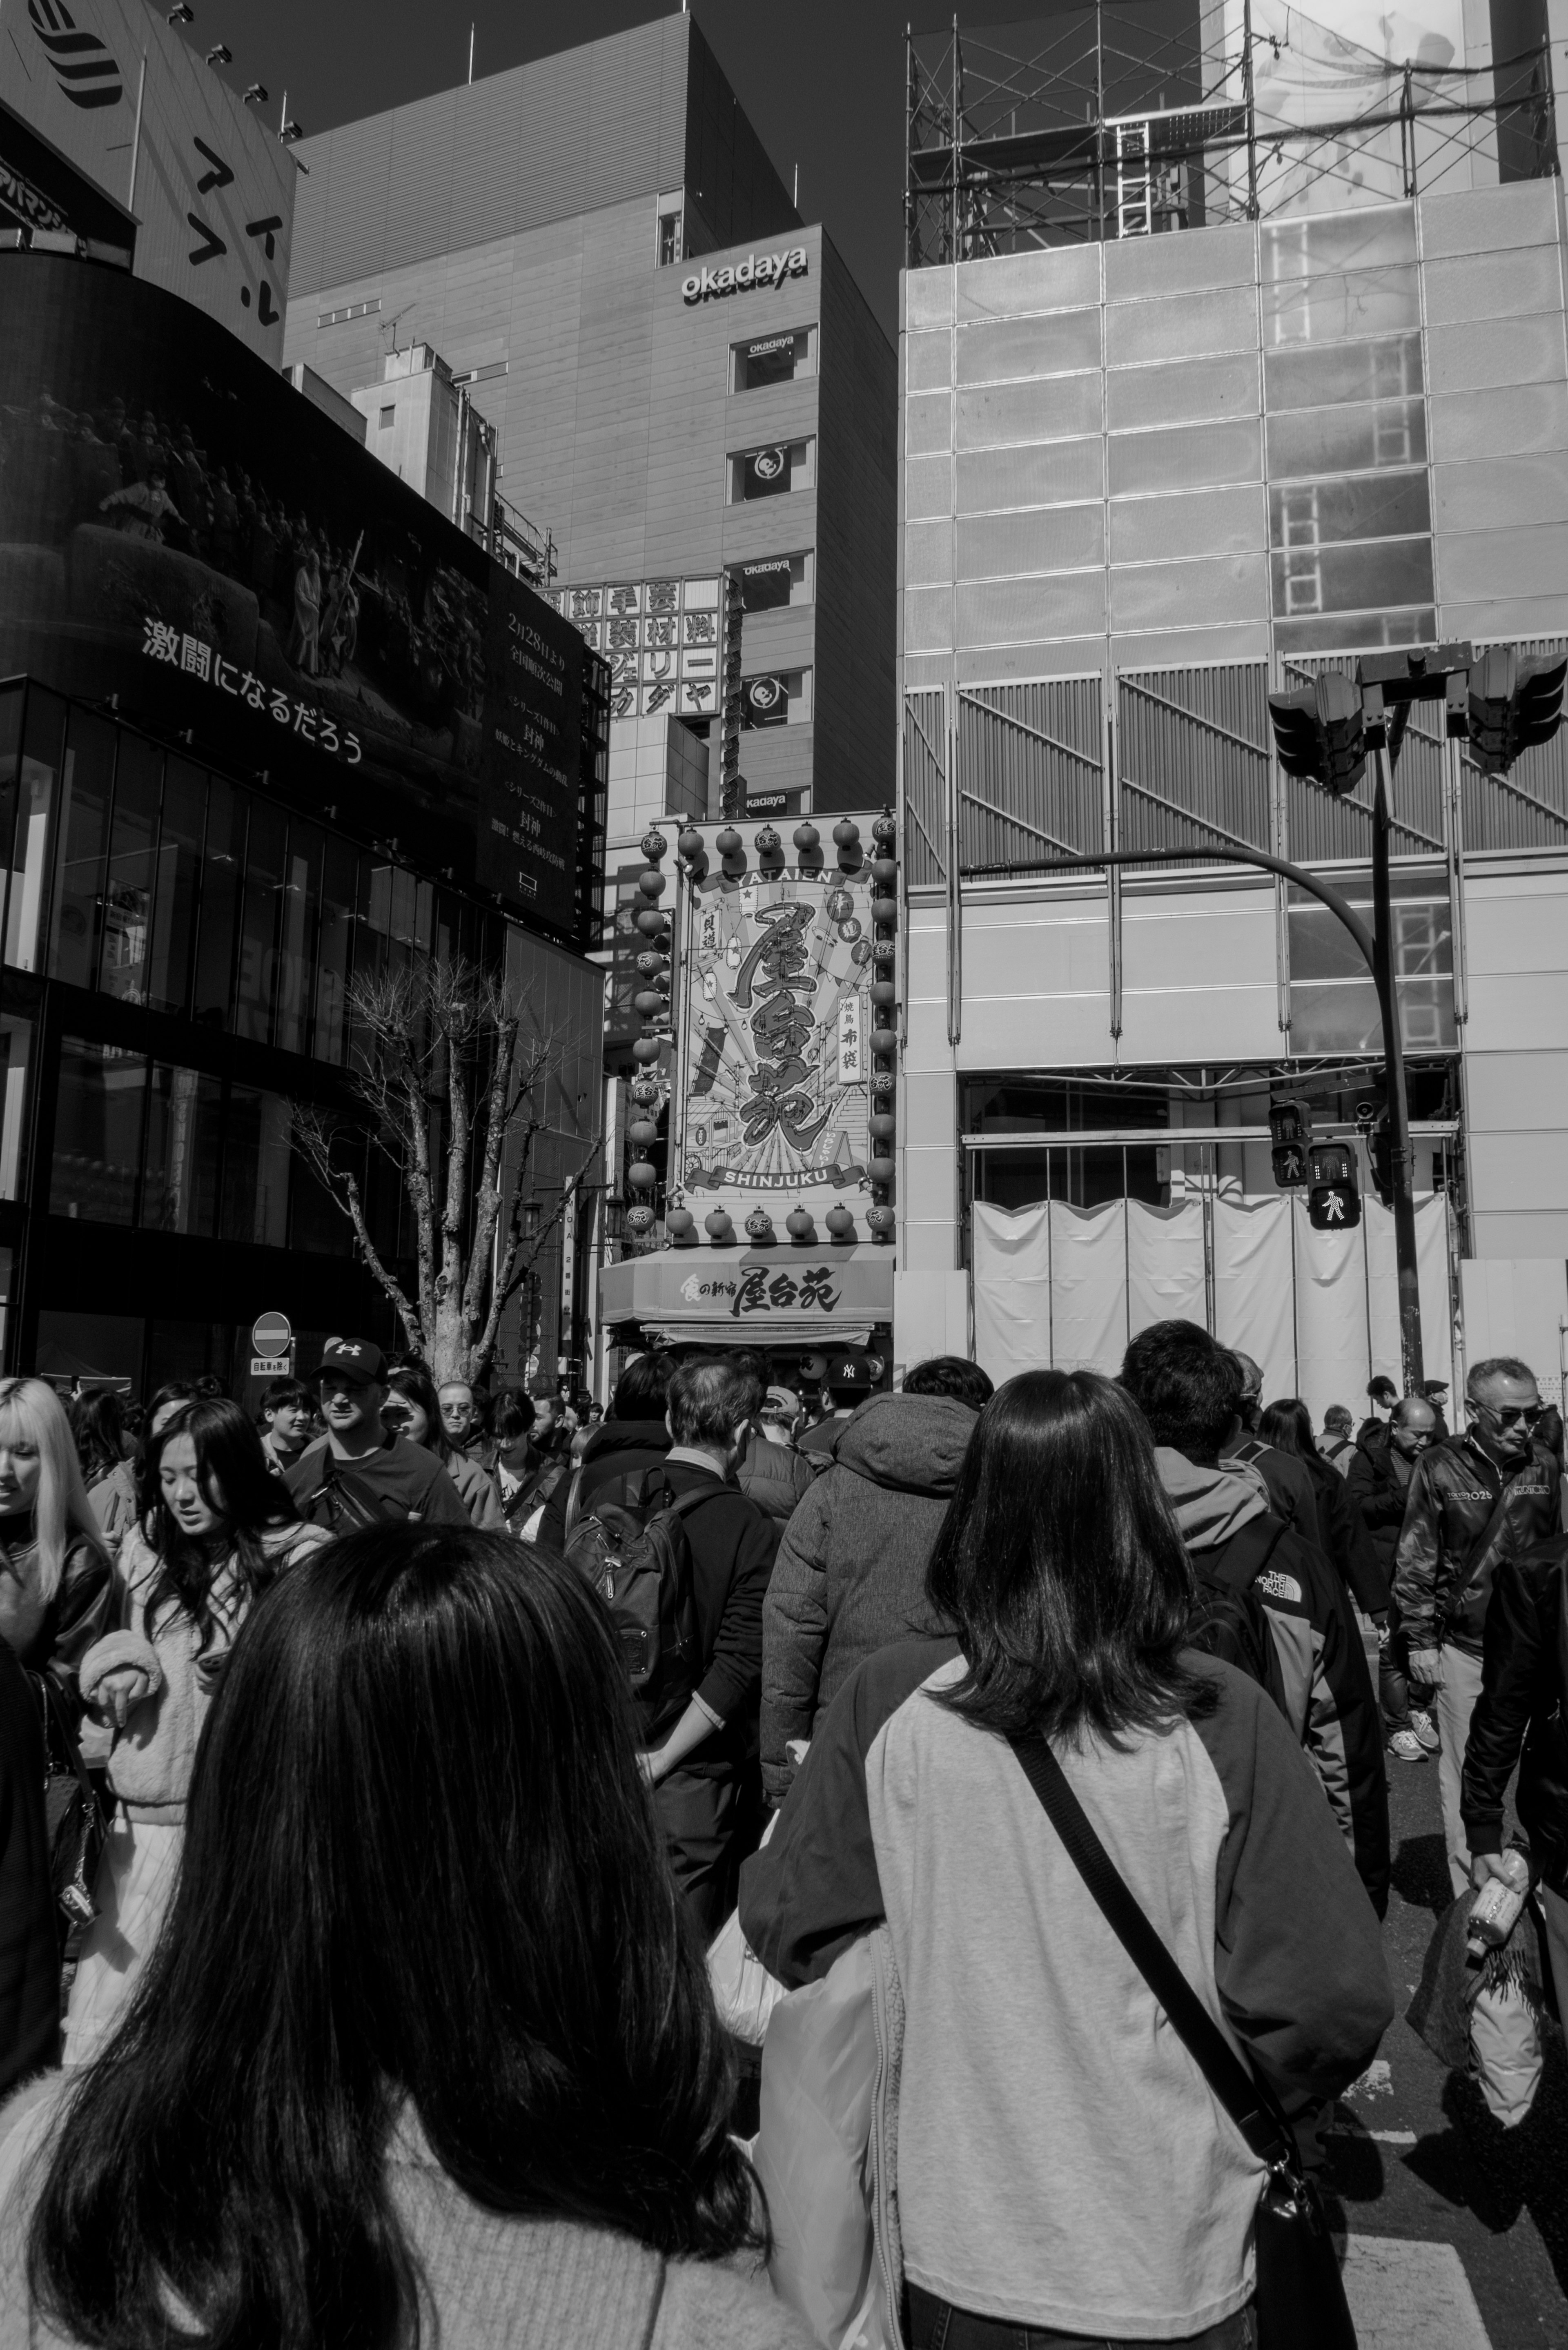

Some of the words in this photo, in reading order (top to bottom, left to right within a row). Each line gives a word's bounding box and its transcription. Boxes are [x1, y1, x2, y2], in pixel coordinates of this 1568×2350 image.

[682, 247, 807, 297] okadaya
[750, 335, 794, 354] okadaya
[744, 559, 789, 575] okadaya
[508, 613, 565, 671] 2月28日より
[510, 644, 562, 697] 全国順次公開
[142, 617, 362, 764] 激闘になるだろう
[523, 724, 544, 752] 封神
[495, 728, 568, 787] 妖姫とキングダムの動乱
[520, 811, 541, 837] 封神
[733, 868, 833, 888] YATAIEN
[726, 902, 833, 1152] 屋台苑
[724, 1169, 828, 1188] SHINJUKU
[254, 1361, 287, 1371] 自転車を除く
[1466, 1490, 1493, 1501] 2025
[1254, 1575, 1285, 1590] NORTH
[1268, 1570, 1287, 1583] THE
[1263, 1584, 1285, 1598] FACE
